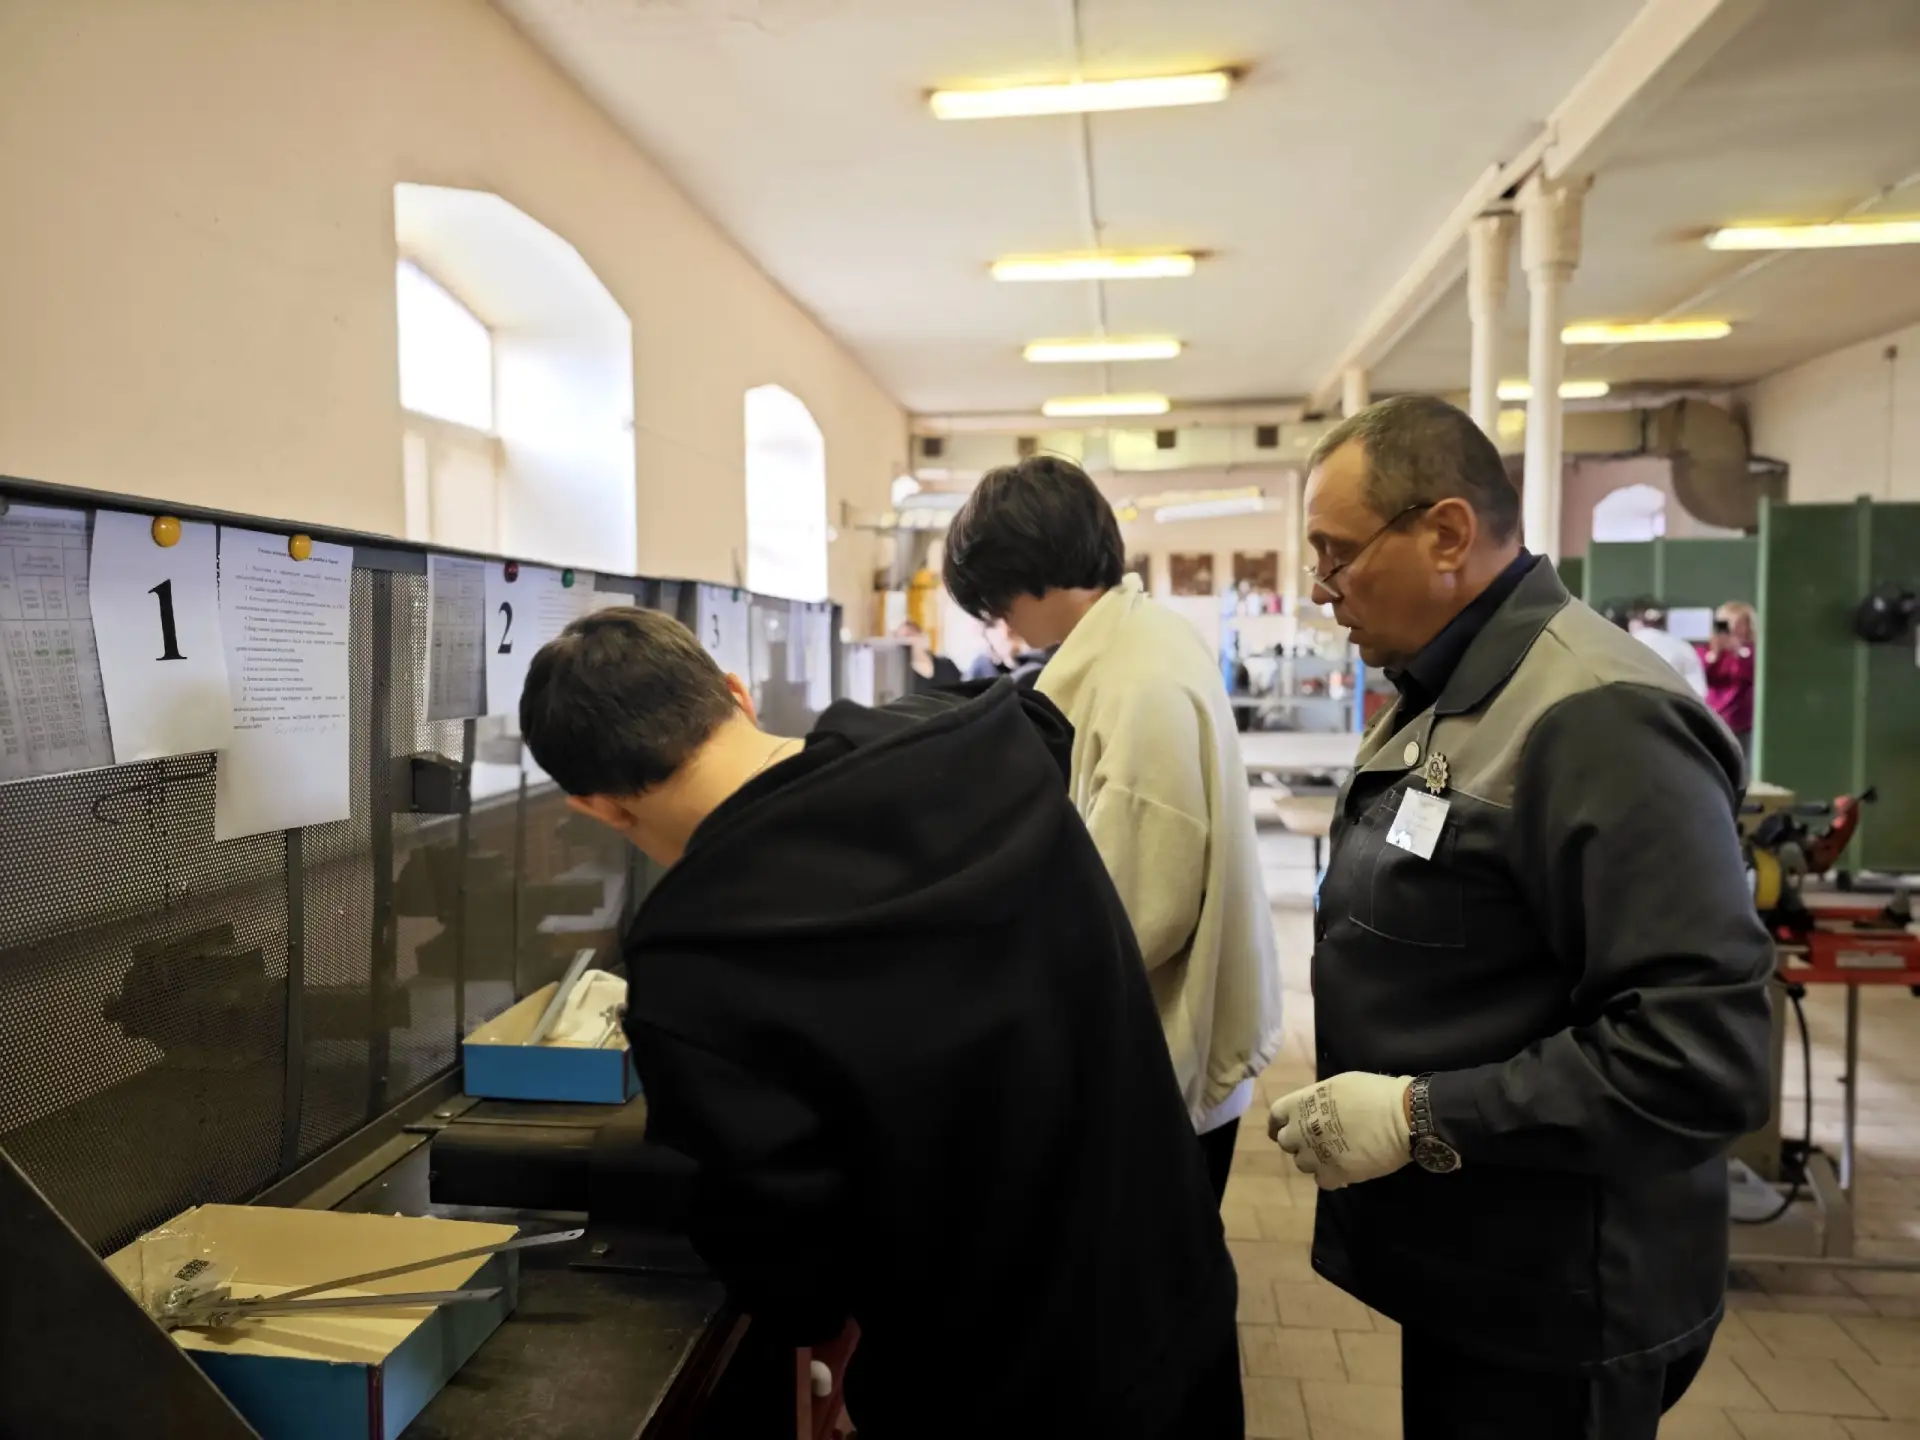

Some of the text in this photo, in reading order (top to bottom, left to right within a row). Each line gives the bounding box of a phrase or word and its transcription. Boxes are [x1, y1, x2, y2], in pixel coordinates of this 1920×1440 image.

[148, 579, 188, 661] 1
[497, 601, 514, 654] 2
[711, 614, 720, 648] 3
